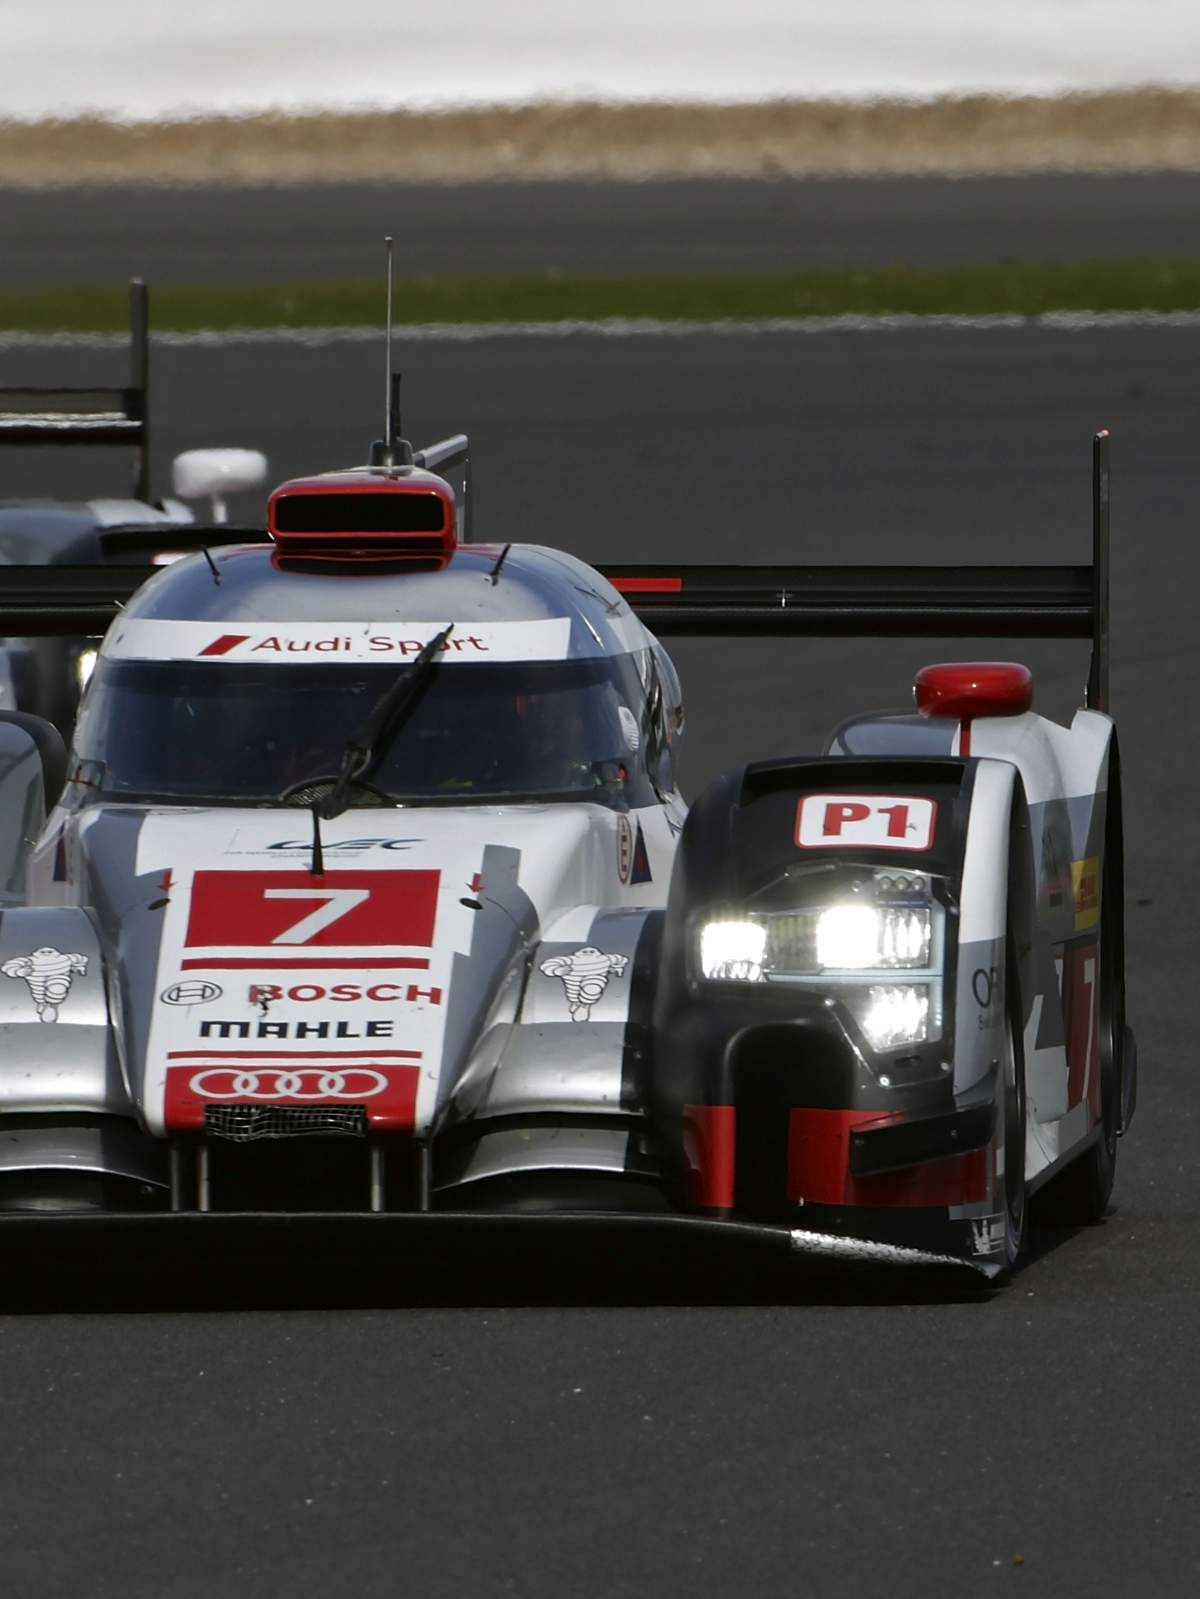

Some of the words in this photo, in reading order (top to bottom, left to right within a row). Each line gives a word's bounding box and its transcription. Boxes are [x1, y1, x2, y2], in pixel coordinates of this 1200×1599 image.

[250, 636, 351, 652] Audi
[822, 802, 909, 838] P1
[263, 888, 370, 944] 7
[250, 983, 442, 1005] BOSCH
[200, 1020, 394, 1038] MAHLE
